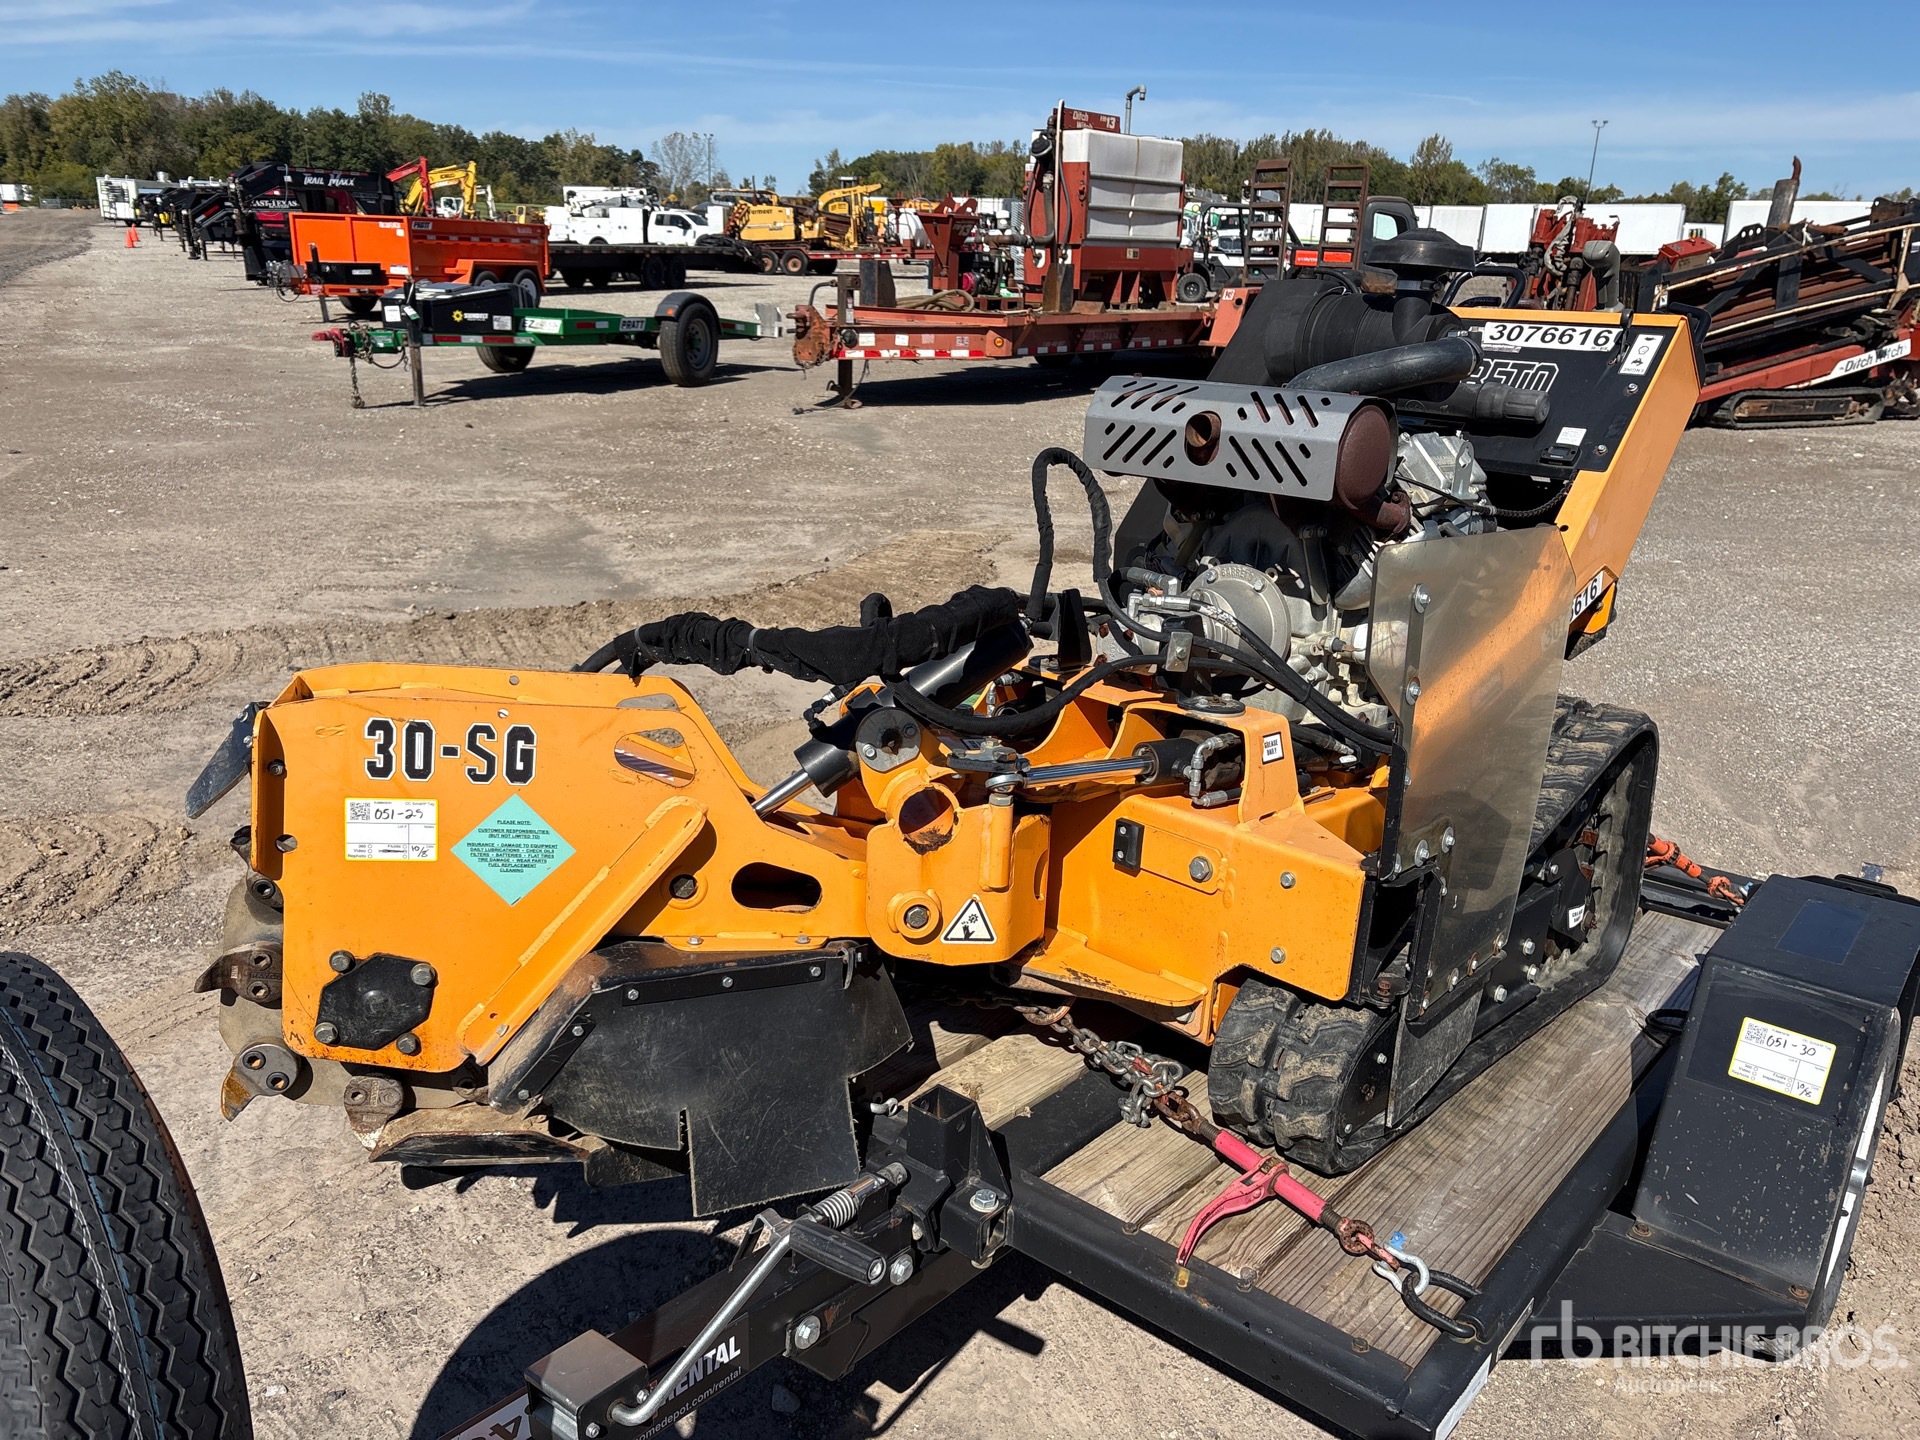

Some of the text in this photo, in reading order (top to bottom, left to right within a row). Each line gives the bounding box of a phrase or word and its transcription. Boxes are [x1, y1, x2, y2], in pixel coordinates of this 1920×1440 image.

[621, 320, 645, 330] PRATT
[1489, 324, 1613, 346] 3076616
[1845, 354, 1874, 372] Ditch
[1570, 578, 1598, 616] 616
[364, 716, 537, 786] 30-SG
[636, 1366, 742, 1440] omedepot.com/rental
